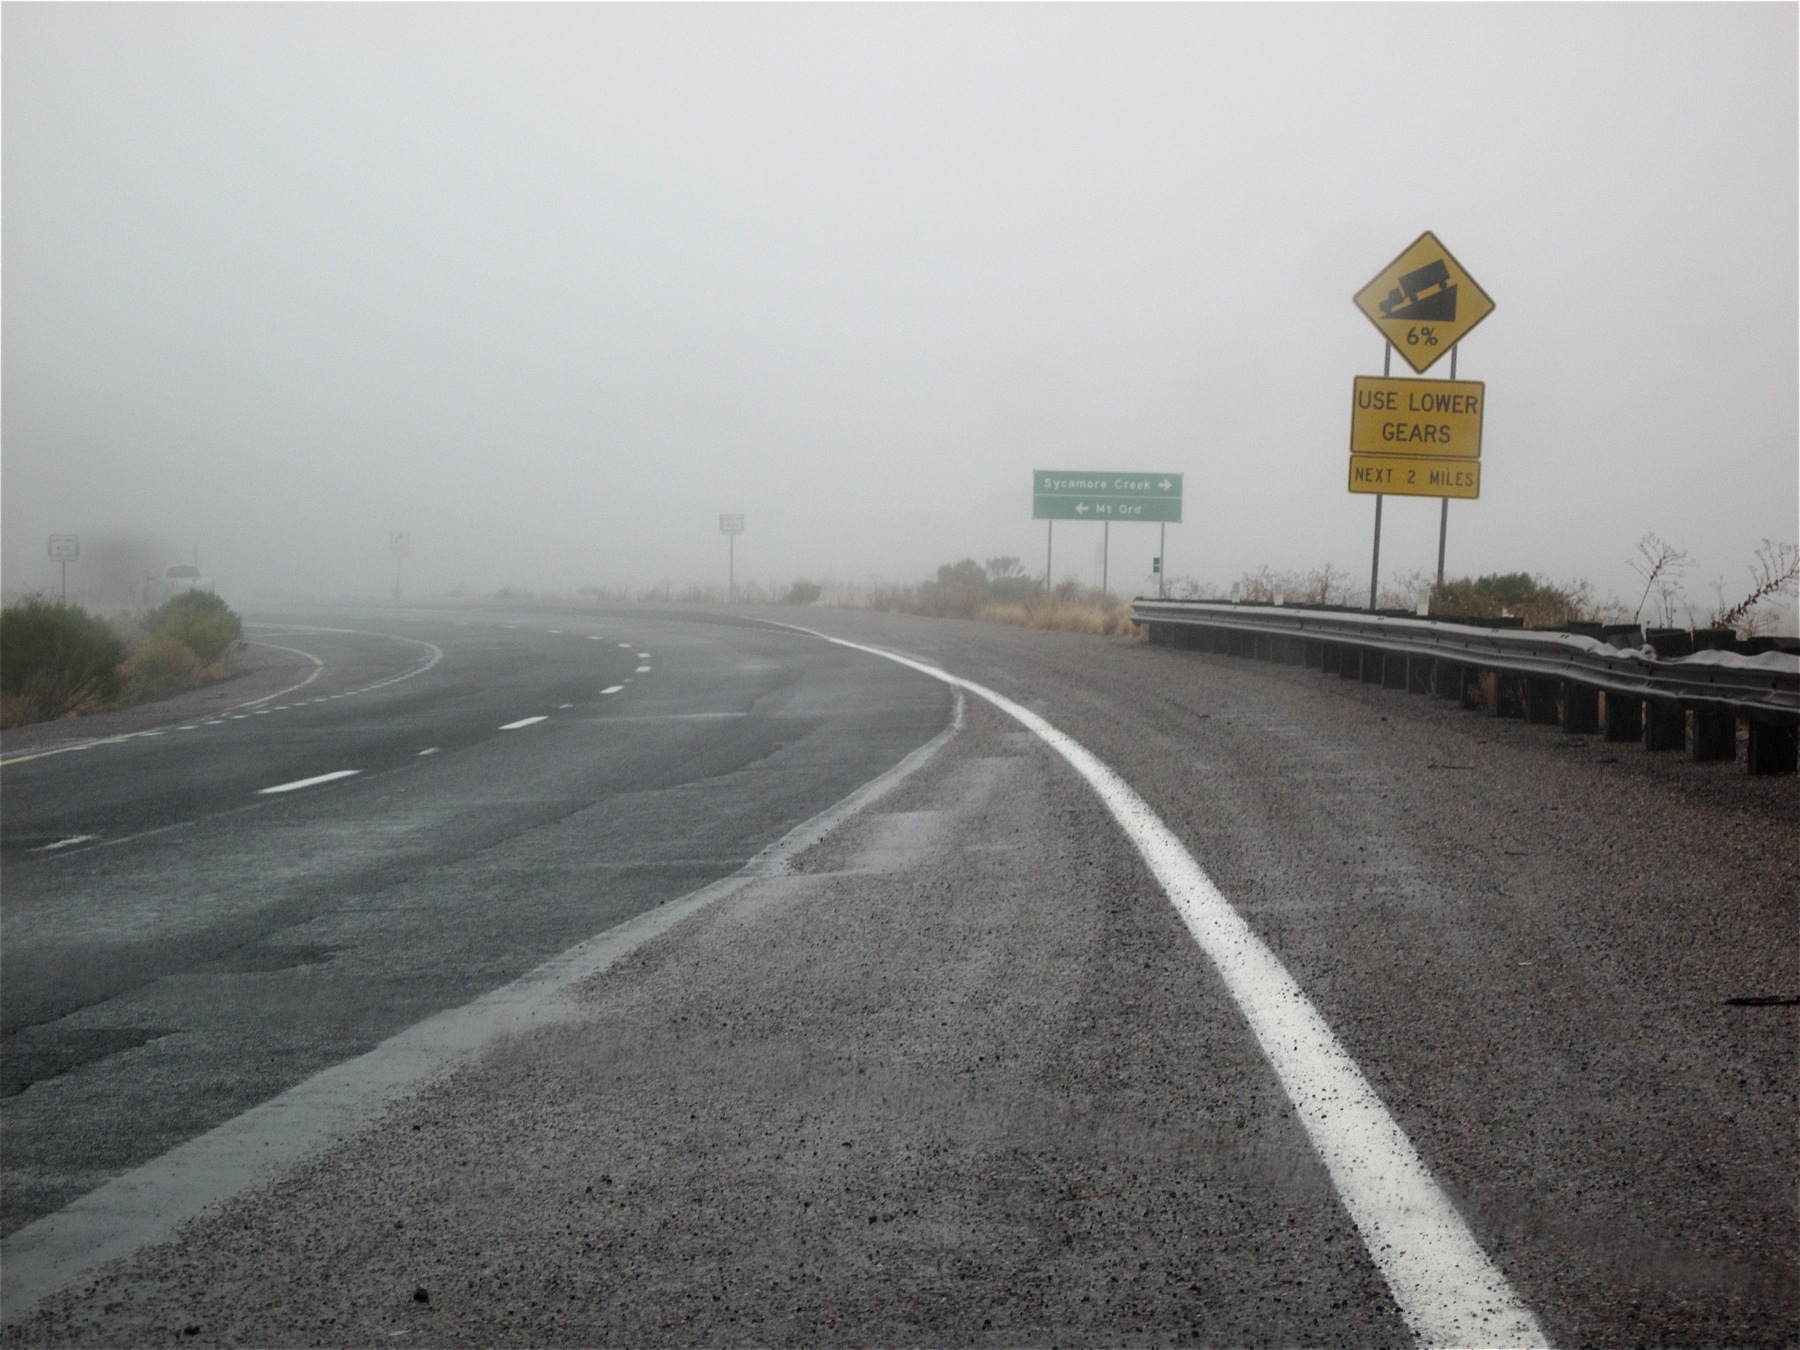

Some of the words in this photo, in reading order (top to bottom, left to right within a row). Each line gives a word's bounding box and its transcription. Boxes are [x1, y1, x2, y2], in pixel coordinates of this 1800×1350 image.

[1407, 326, 1438, 346] 6%
[1358, 391, 1398, 410] USE
[1409, 393, 1478, 414] LOWER
[1382, 423, 1450, 443] GEARS
[1044, 478, 1107, 490] Sycamore
[1115, 479, 1150, 490] Creek
[1355, 467, 1393, 483] NEXT
[1407, 470, 1416, 485] 2
[1430, 472, 1473, 487] MILES
[1096, 504, 1112, 514] Mt
[1119, 504, 1141, 515] Ord
